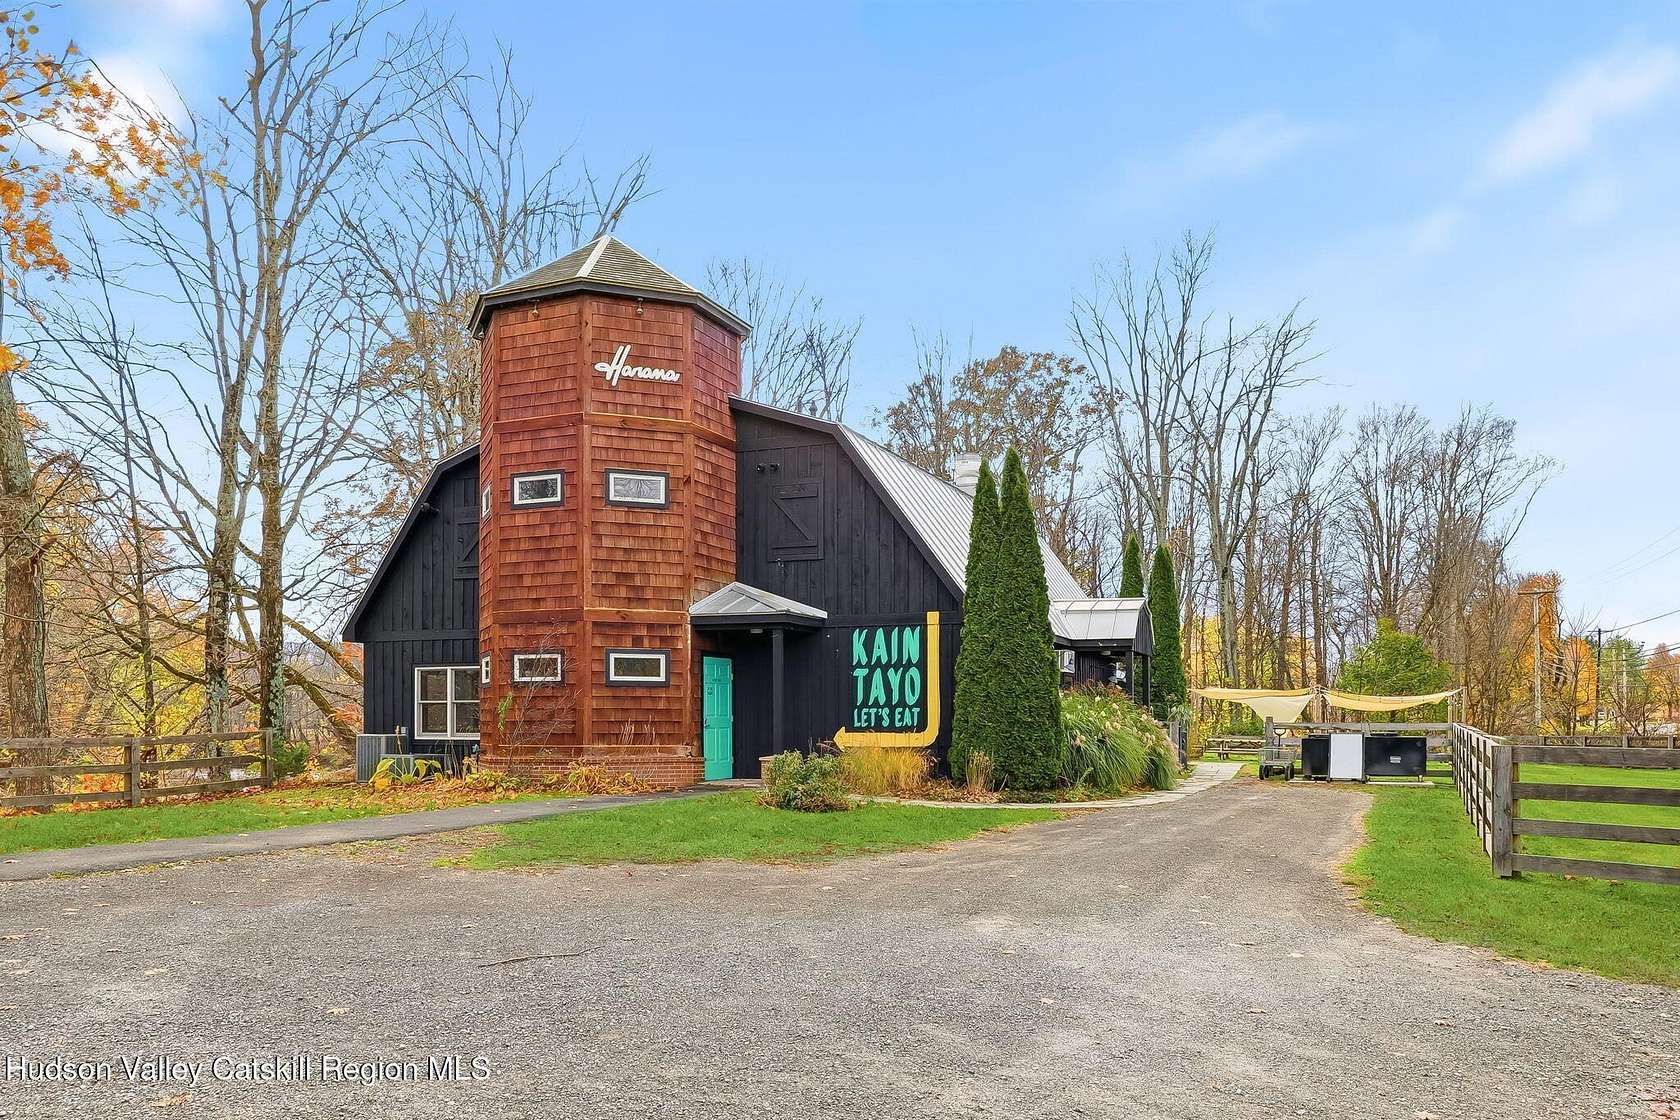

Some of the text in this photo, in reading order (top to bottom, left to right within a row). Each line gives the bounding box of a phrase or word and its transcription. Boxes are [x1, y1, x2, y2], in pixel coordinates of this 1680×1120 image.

[852, 626, 920, 666] KAIN
[852, 666, 921, 706] TAYO
[853, 708, 920, 727] LET'S EAT
